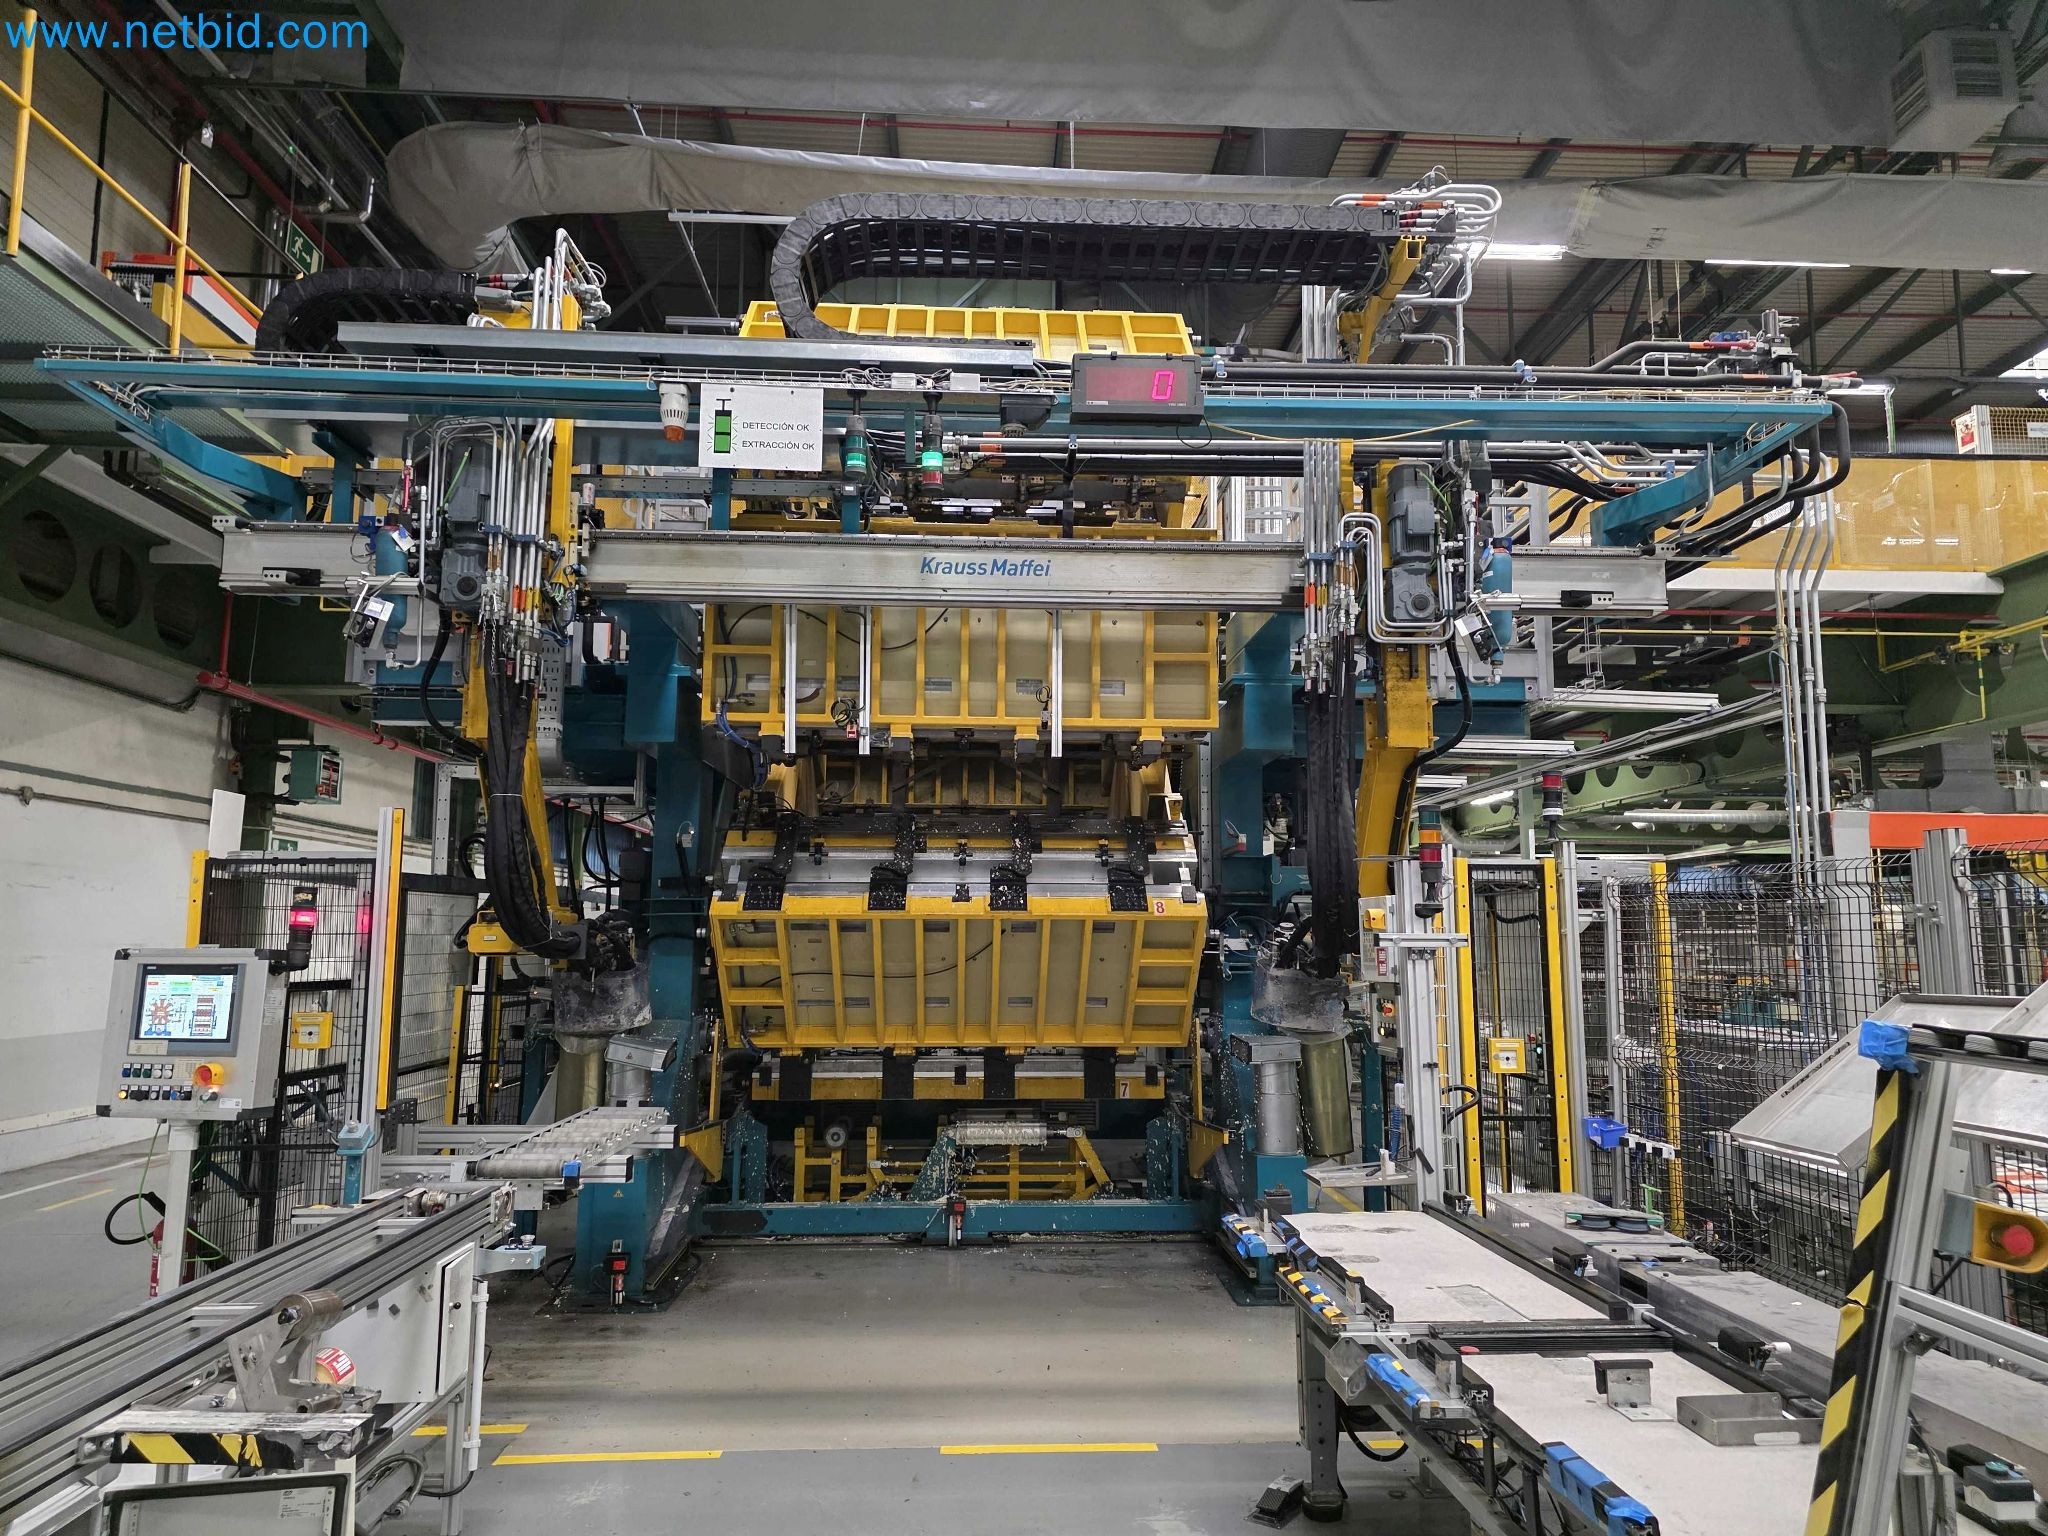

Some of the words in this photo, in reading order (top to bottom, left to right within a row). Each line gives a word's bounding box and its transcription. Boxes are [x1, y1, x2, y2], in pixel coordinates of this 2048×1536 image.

[1152, 370, 1175, 400] 0
[742, 421, 794, 432] DETECCIÓN
[796, 423, 810, 432] OK
[742, 440, 800, 450] EXTRACCIÓN
[802, 442, 815, 451] OK
[1156, 901, 1165, 914] 8
[1120, 1082, 1129, 1098] 7
